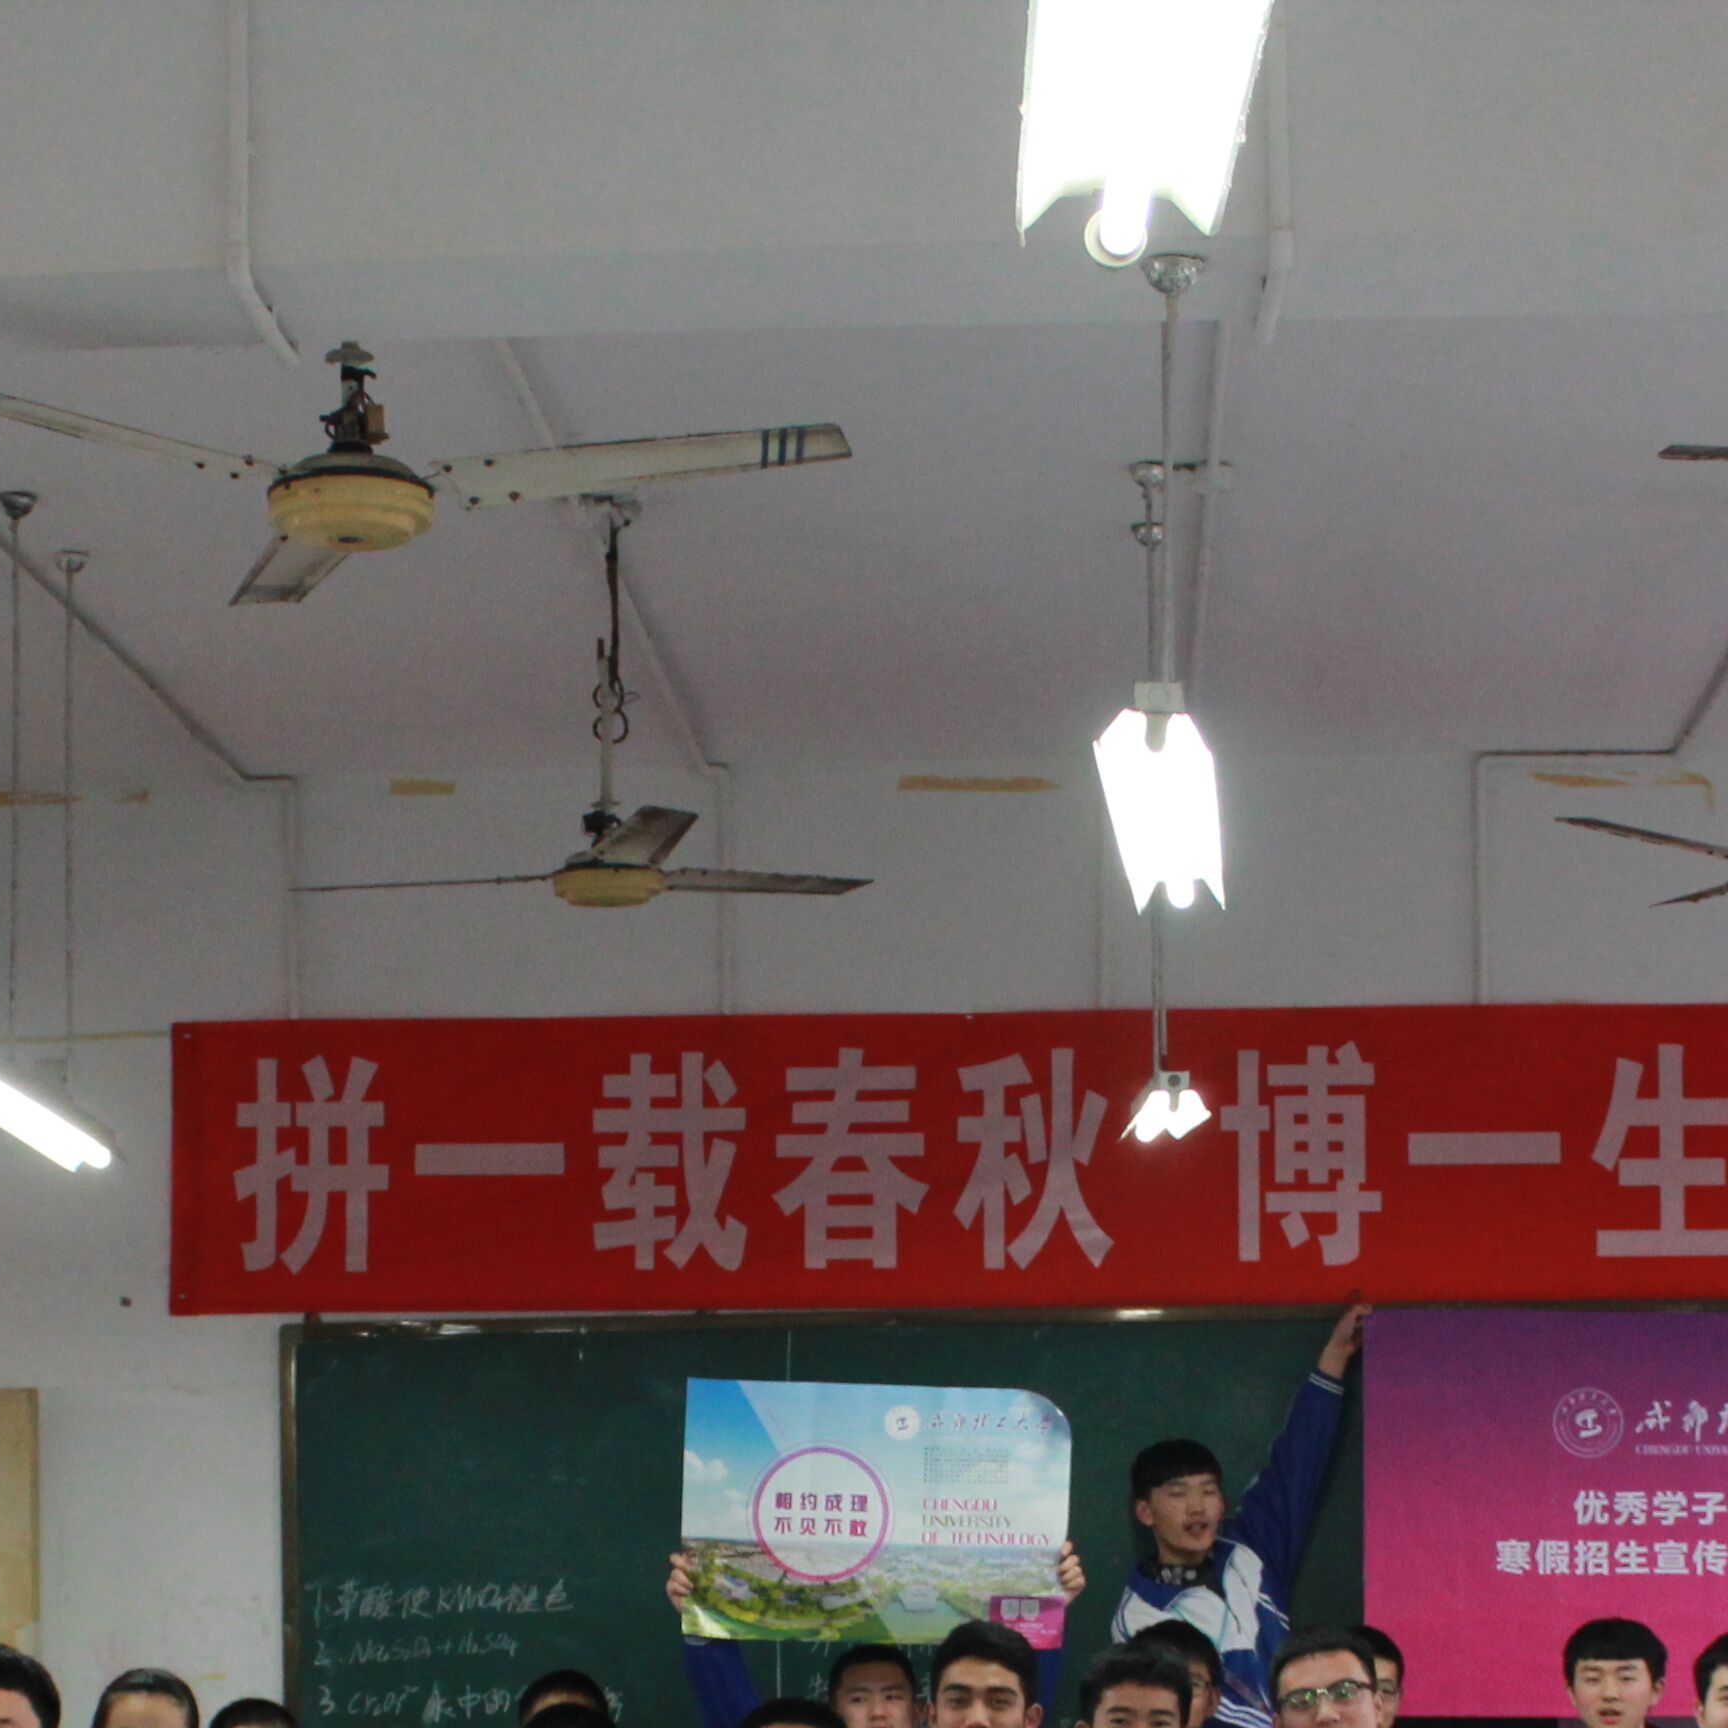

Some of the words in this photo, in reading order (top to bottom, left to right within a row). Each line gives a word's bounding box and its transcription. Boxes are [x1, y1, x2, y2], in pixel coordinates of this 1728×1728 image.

[232, 1046, 1114, 1274] 拼一载春秋
[925, 1410, 1053, 1434] 成都理工大学
[1635, 1445, 1692, 1457] CHENGDU
[775, 1491, 869, 1514] 相约成理
[922, 1497, 998, 1512] CHENGDU
[774, 1516, 869, 1538] 不见不散
[922, 1515, 1013, 1529] UNIVERSITY
[921, 1532, 945, 1545] OF
[951, 1533, 1054, 1547] TECHNOLOGY
